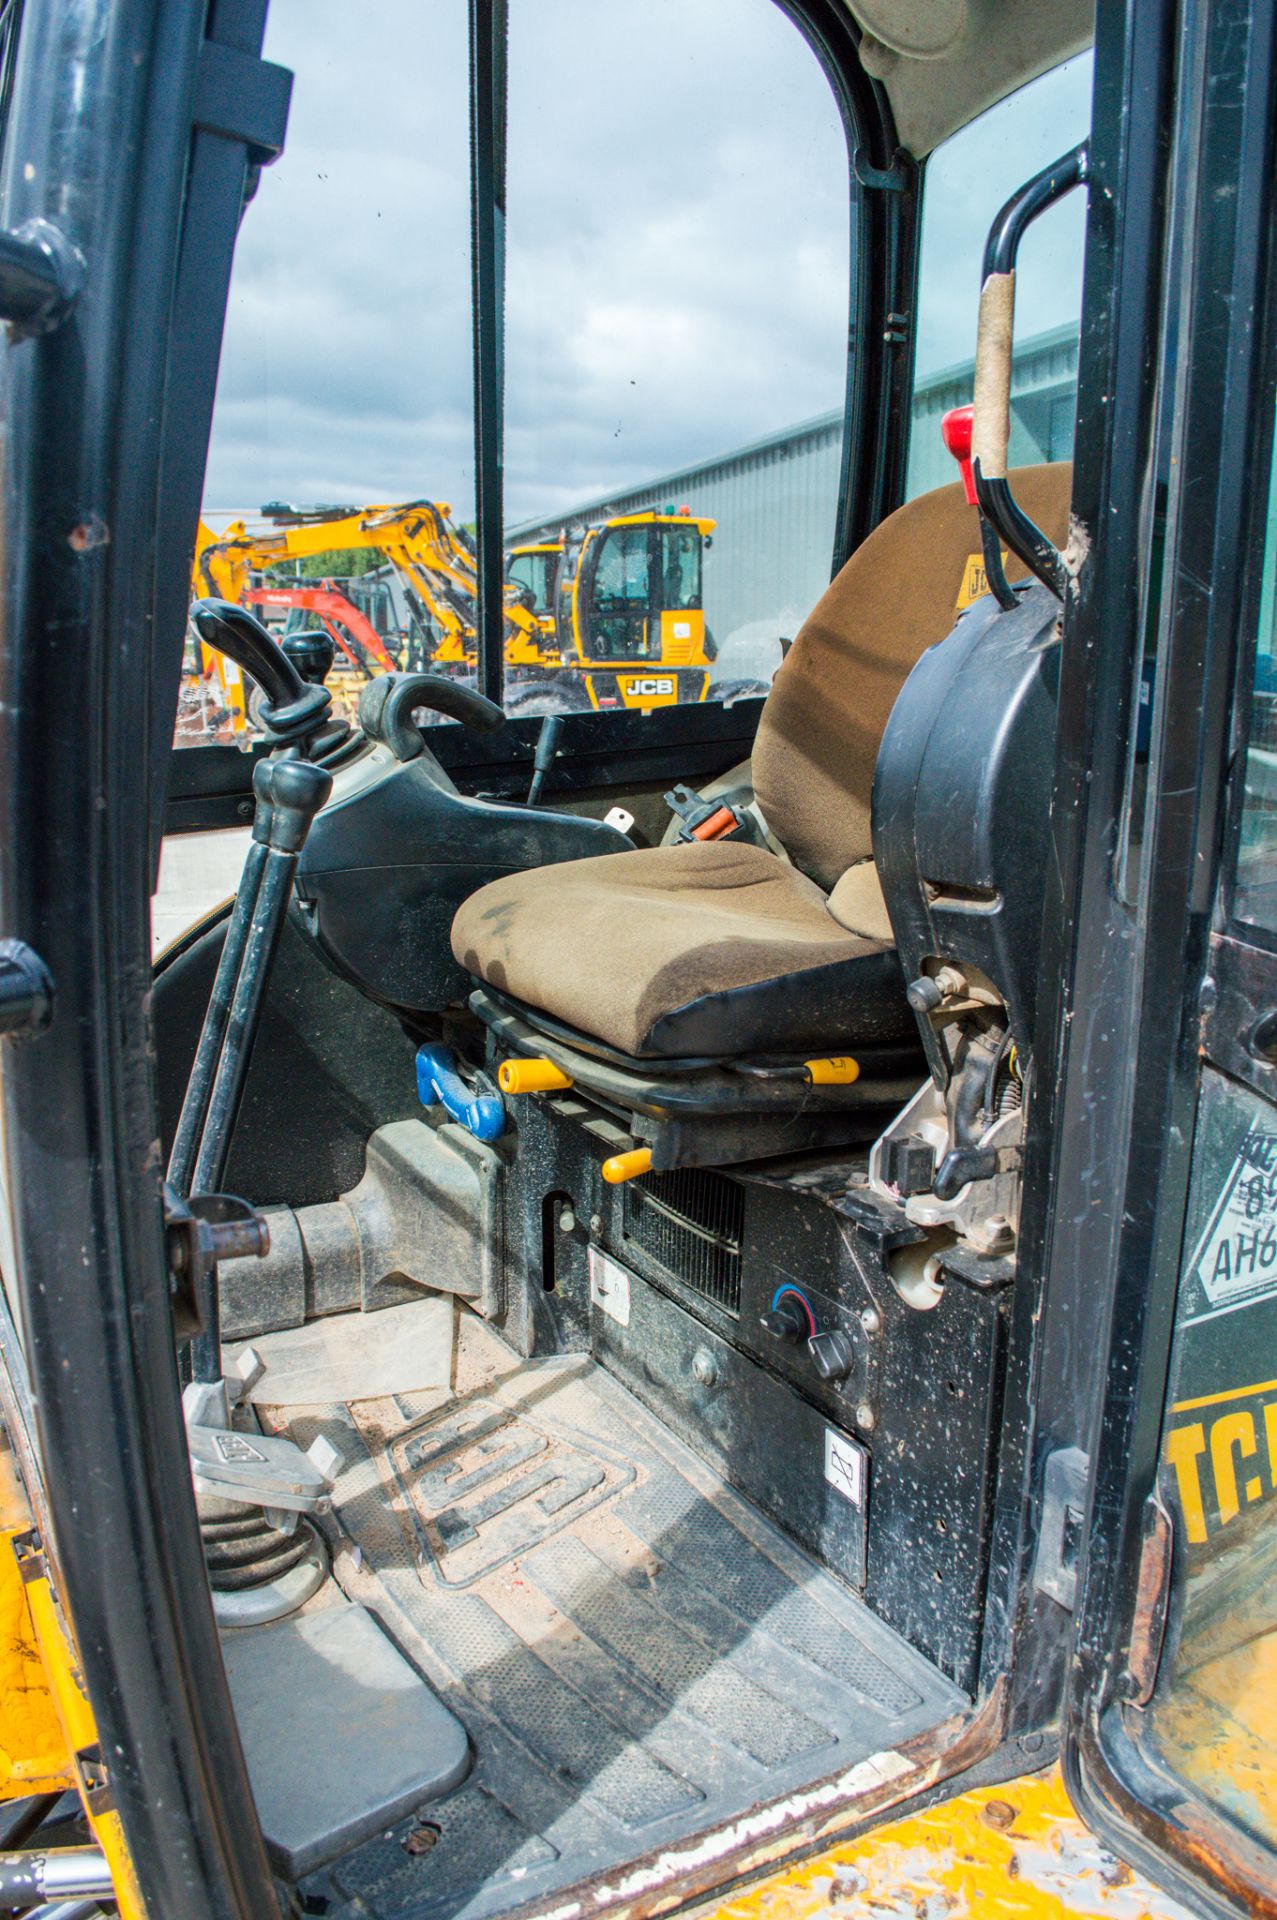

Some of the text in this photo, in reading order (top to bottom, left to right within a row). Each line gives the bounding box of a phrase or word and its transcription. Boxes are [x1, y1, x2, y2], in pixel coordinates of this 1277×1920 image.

[626, 679, 674, 696] JCB
[404, 1402, 606, 1552] JCB
[1166, 1402, 1277, 1544] TC
